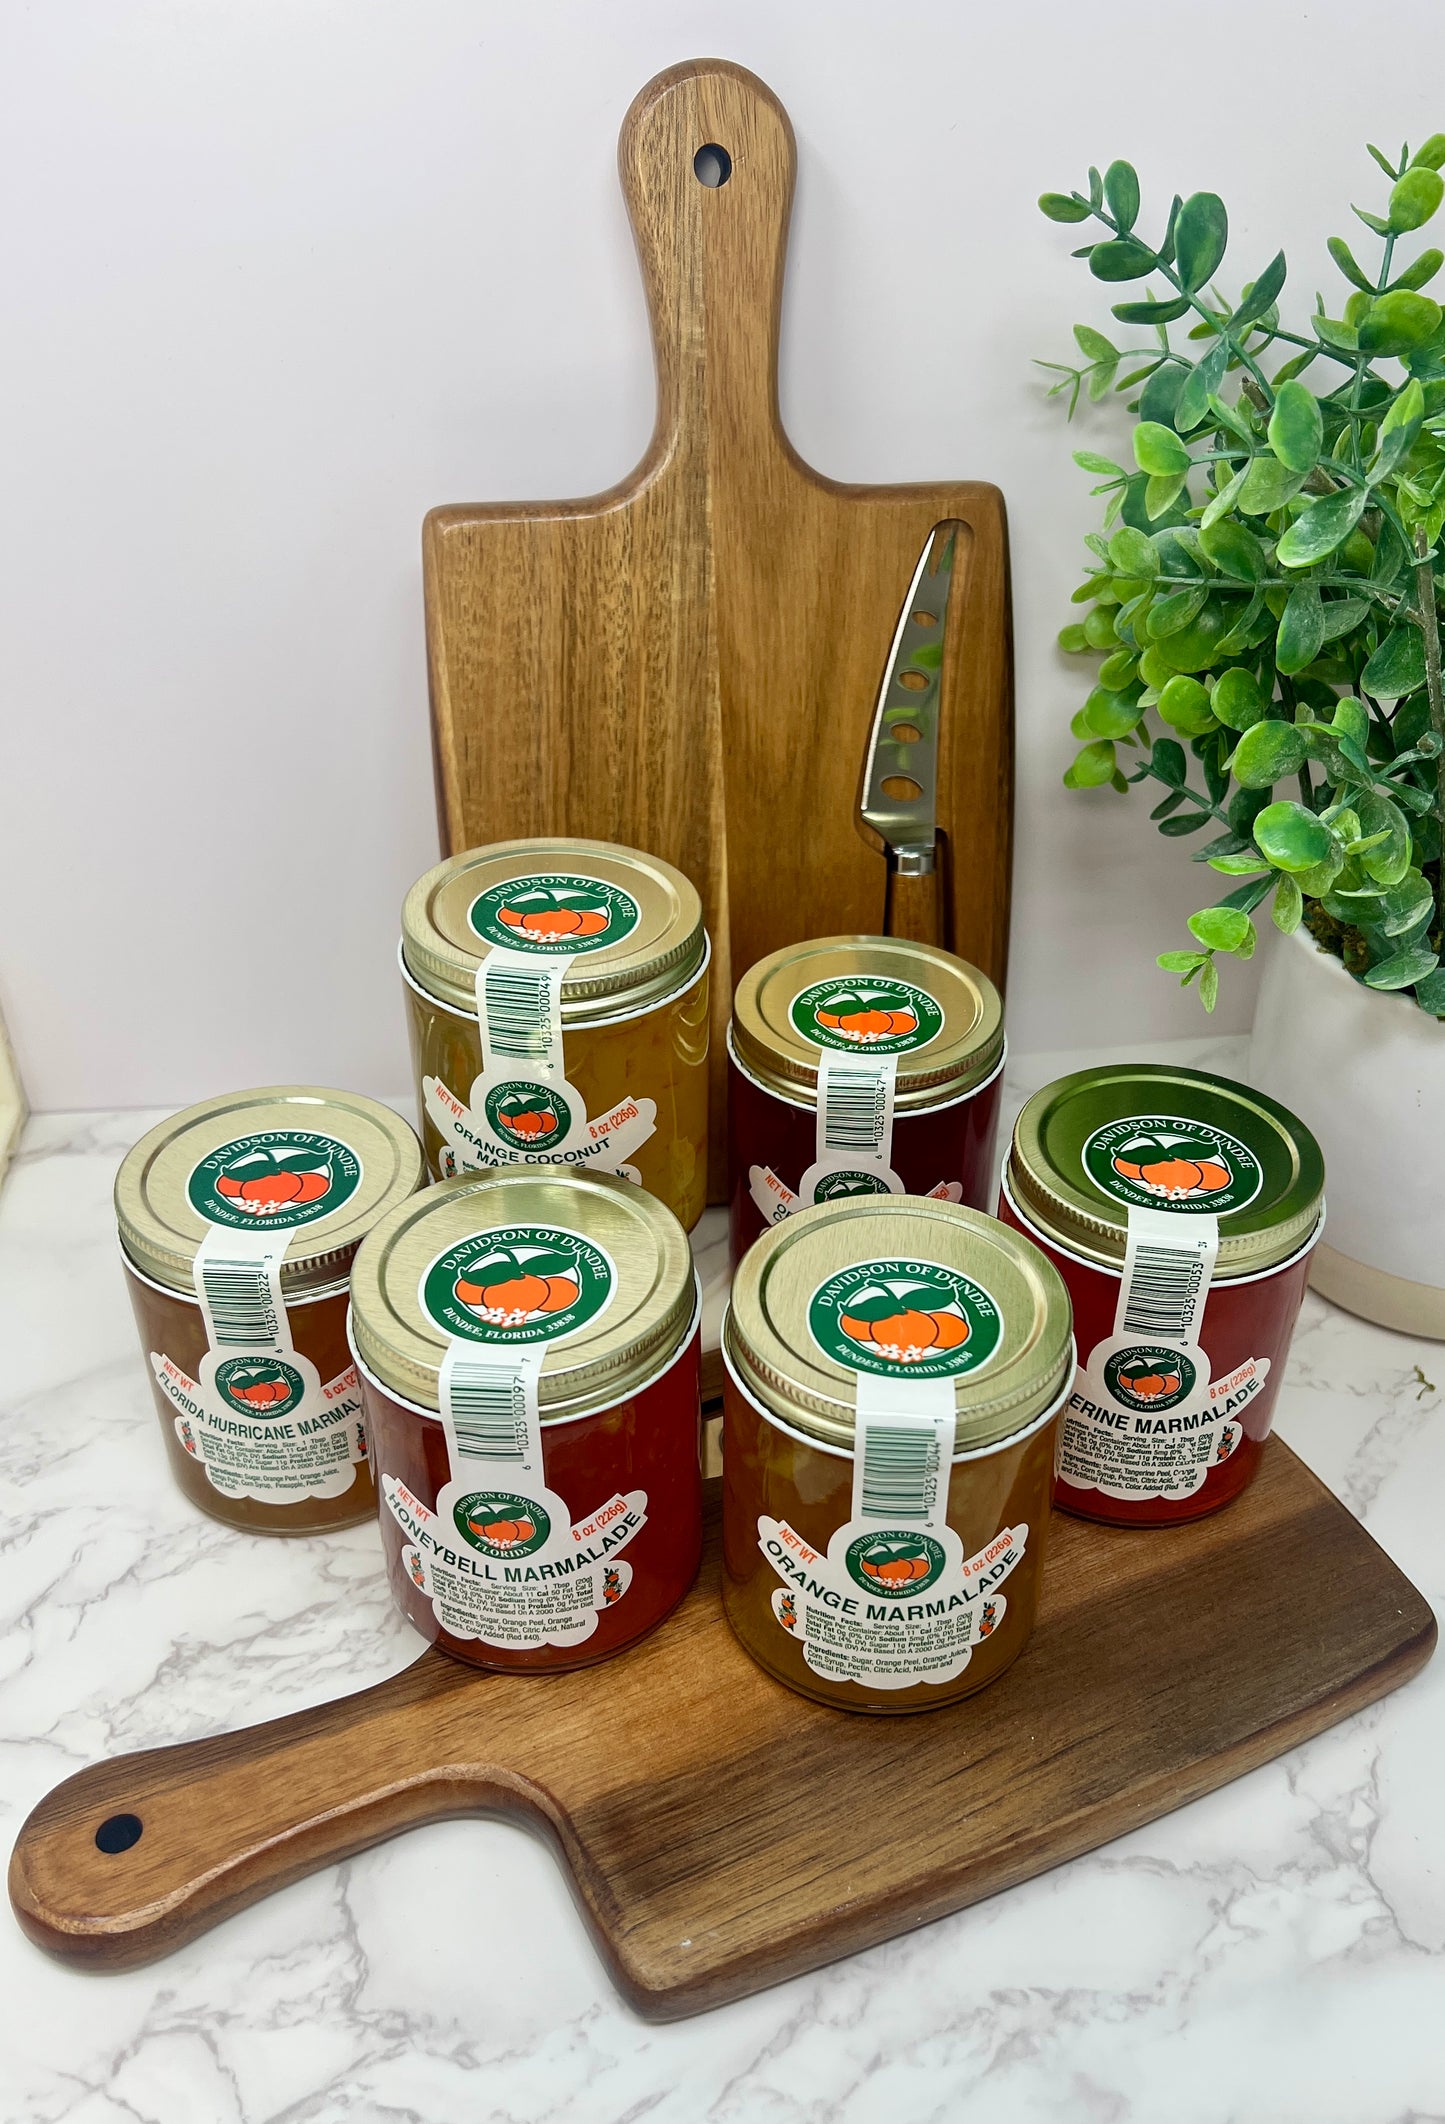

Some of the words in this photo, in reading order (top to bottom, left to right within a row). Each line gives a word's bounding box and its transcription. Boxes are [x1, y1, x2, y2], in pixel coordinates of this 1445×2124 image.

[485, 878, 567, 902] DAVIDSON
[573, 879, 595, 888] OF
[595, 886, 635, 918] DUNDEE
[523, 943, 575, 951] FLORIDA
[540, 976, 552, 1012] 00049
[800, 979, 868, 1006] DAVIDSON
[873, 980, 894, 989] OF
[896, 985, 939, 1017] DUNDEE
[541, 1018, 552, 1048] 10325
[436, 1085, 451, 1104] NET
[451, 1101, 464, 1118] WT
[488, 1083, 522, 1107] DAVIDSON
[875, 1079, 886, 1110] 00047
[589, 1127, 597, 1138] 8
[599, 1122, 611, 1135] oz
[609, 1103, 639, 1130] (226g)
[874, 1115, 884, 1141] 10325
[203, 1134, 289, 1170] DAVIDSON
[294, 1134, 317, 1144] OF
[316, 1139, 357, 1177] DUNDEE
[454, 1122, 519, 1162] ORANGE
[525, 1137, 611, 1164] COCONUT
[1092, 1120, 1167, 1151] DAVIDSON
[1172, 1122, 1197, 1132] OF
[1199, 1129, 1255, 1169] DUNDEE
[764, 1174, 783, 1192] NET
[779, 1190, 794, 1204] WT
[817, 1172, 851, 1193] DAVIDSON
[867, 1176, 888, 1193] DUND
[240, 1216, 295, 1226] FLORIDA
[296, 1204, 323, 1220] 33838
[1156, 1202, 1210, 1210] FLORIDA
[441, 1229, 531, 1270] DAVIDSON
[535, 1231, 560, 1242] OF
[560, 1236, 608, 1280] DUNDEE
[258, 1273, 273, 1304] 00222
[818, 1263, 900, 1307] DAVIDSON
[905, 1264, 932, 1276] OF
[934, 1271, 995, 1317] DUNDEE
[1187, 1263, 1204, 1294] 00053
[264, 1309, 279, 1336] 10325
[485, 1329, 545, 1340] FLORIDA
[546, 1314, 576, 1333] 33838
[1181, 1298, 1196, 1327] 10325
[218, 1358, 251, 1381] DAVIDSON
[886, 1364, 947, 1374] FLORIDA
[1109, 1347, 1152, 1368] DAVIDSON
[163, 1361, 180, 1380] NET
[180, 1374, 195, 1392] WT
[324, 1388, 333, 1399] 8
[333, 1383, 346, 1394] oz
[1209, 1388, 1216, 1399] 8
[1217, 1382, 1229, 1394] oz
[1229, 1364, 1256, 1390] (226g)
[159, 1371, 205, 1422] FLORIDA
[208, 1414, 296, 1440] HURRICANE
[297, 1398, 360, 1436] MARMAL
[513, 1377, 526, 1416] 00097
[1069, 1393, 1130, 1431] ERINE
[1135, 1378, 1260, 1434] MARMALADE
[515, 1421, 529, 1451] 10325
[926, 1443, 941, 1473] 00044
[397, 1486, 415, 1506] NET
[415, 1505, 430, 1522] WT
[457, 1493, 495, 1514] DAVIDSON
[513, 1497, 548, 1520] DUNDEE
[924, 1477, 937, 1508] 10325
[572, 1530, 581, 1541] 8
[582, 1524, 596, 1537] oz
[594, 1500, 628, 1529] (226g)
[389, 1493, 497, 1580] HONEYBELL
[504, 1512, 640, 1583] MARMALADE
[474, 1542, 532, 1558] FLORIDA
[779, 1528, 801, 1549] NET
[799, 1546, 818, 1564] WT
[849, 1532, 895, 1556] DAVIDSON
[963, 1565, 971, 1576] 8
[972, 1559, 985, 1572] oz
[984, 1534, 1014, 1563] (226g)
[767, 1540, 859, 1615] ORANGE
[866, 1549, 1018, 1622] MARMALADE
[561, 1620, 585, 1630] Natural
[806, 1605, 835, 1620] Nutrition
[841, 1618, 862, 1626] Facts:
[807, 1657, 833, 1671] Artificial
[836, 1667, 862, 1678] Flavors.
[808, 1643, 850, 1660] Ingredients:
[852, 1656, 873, 1665] Sugar,
[923, 1654, 947, 1663] Orange
[808, 1650, 822, 1660] Corn
[848, 1662, 871, 1672] Pectin,
[913, 1663, 938, 1672] Natural
[940, 1659, 952, 1667] and
